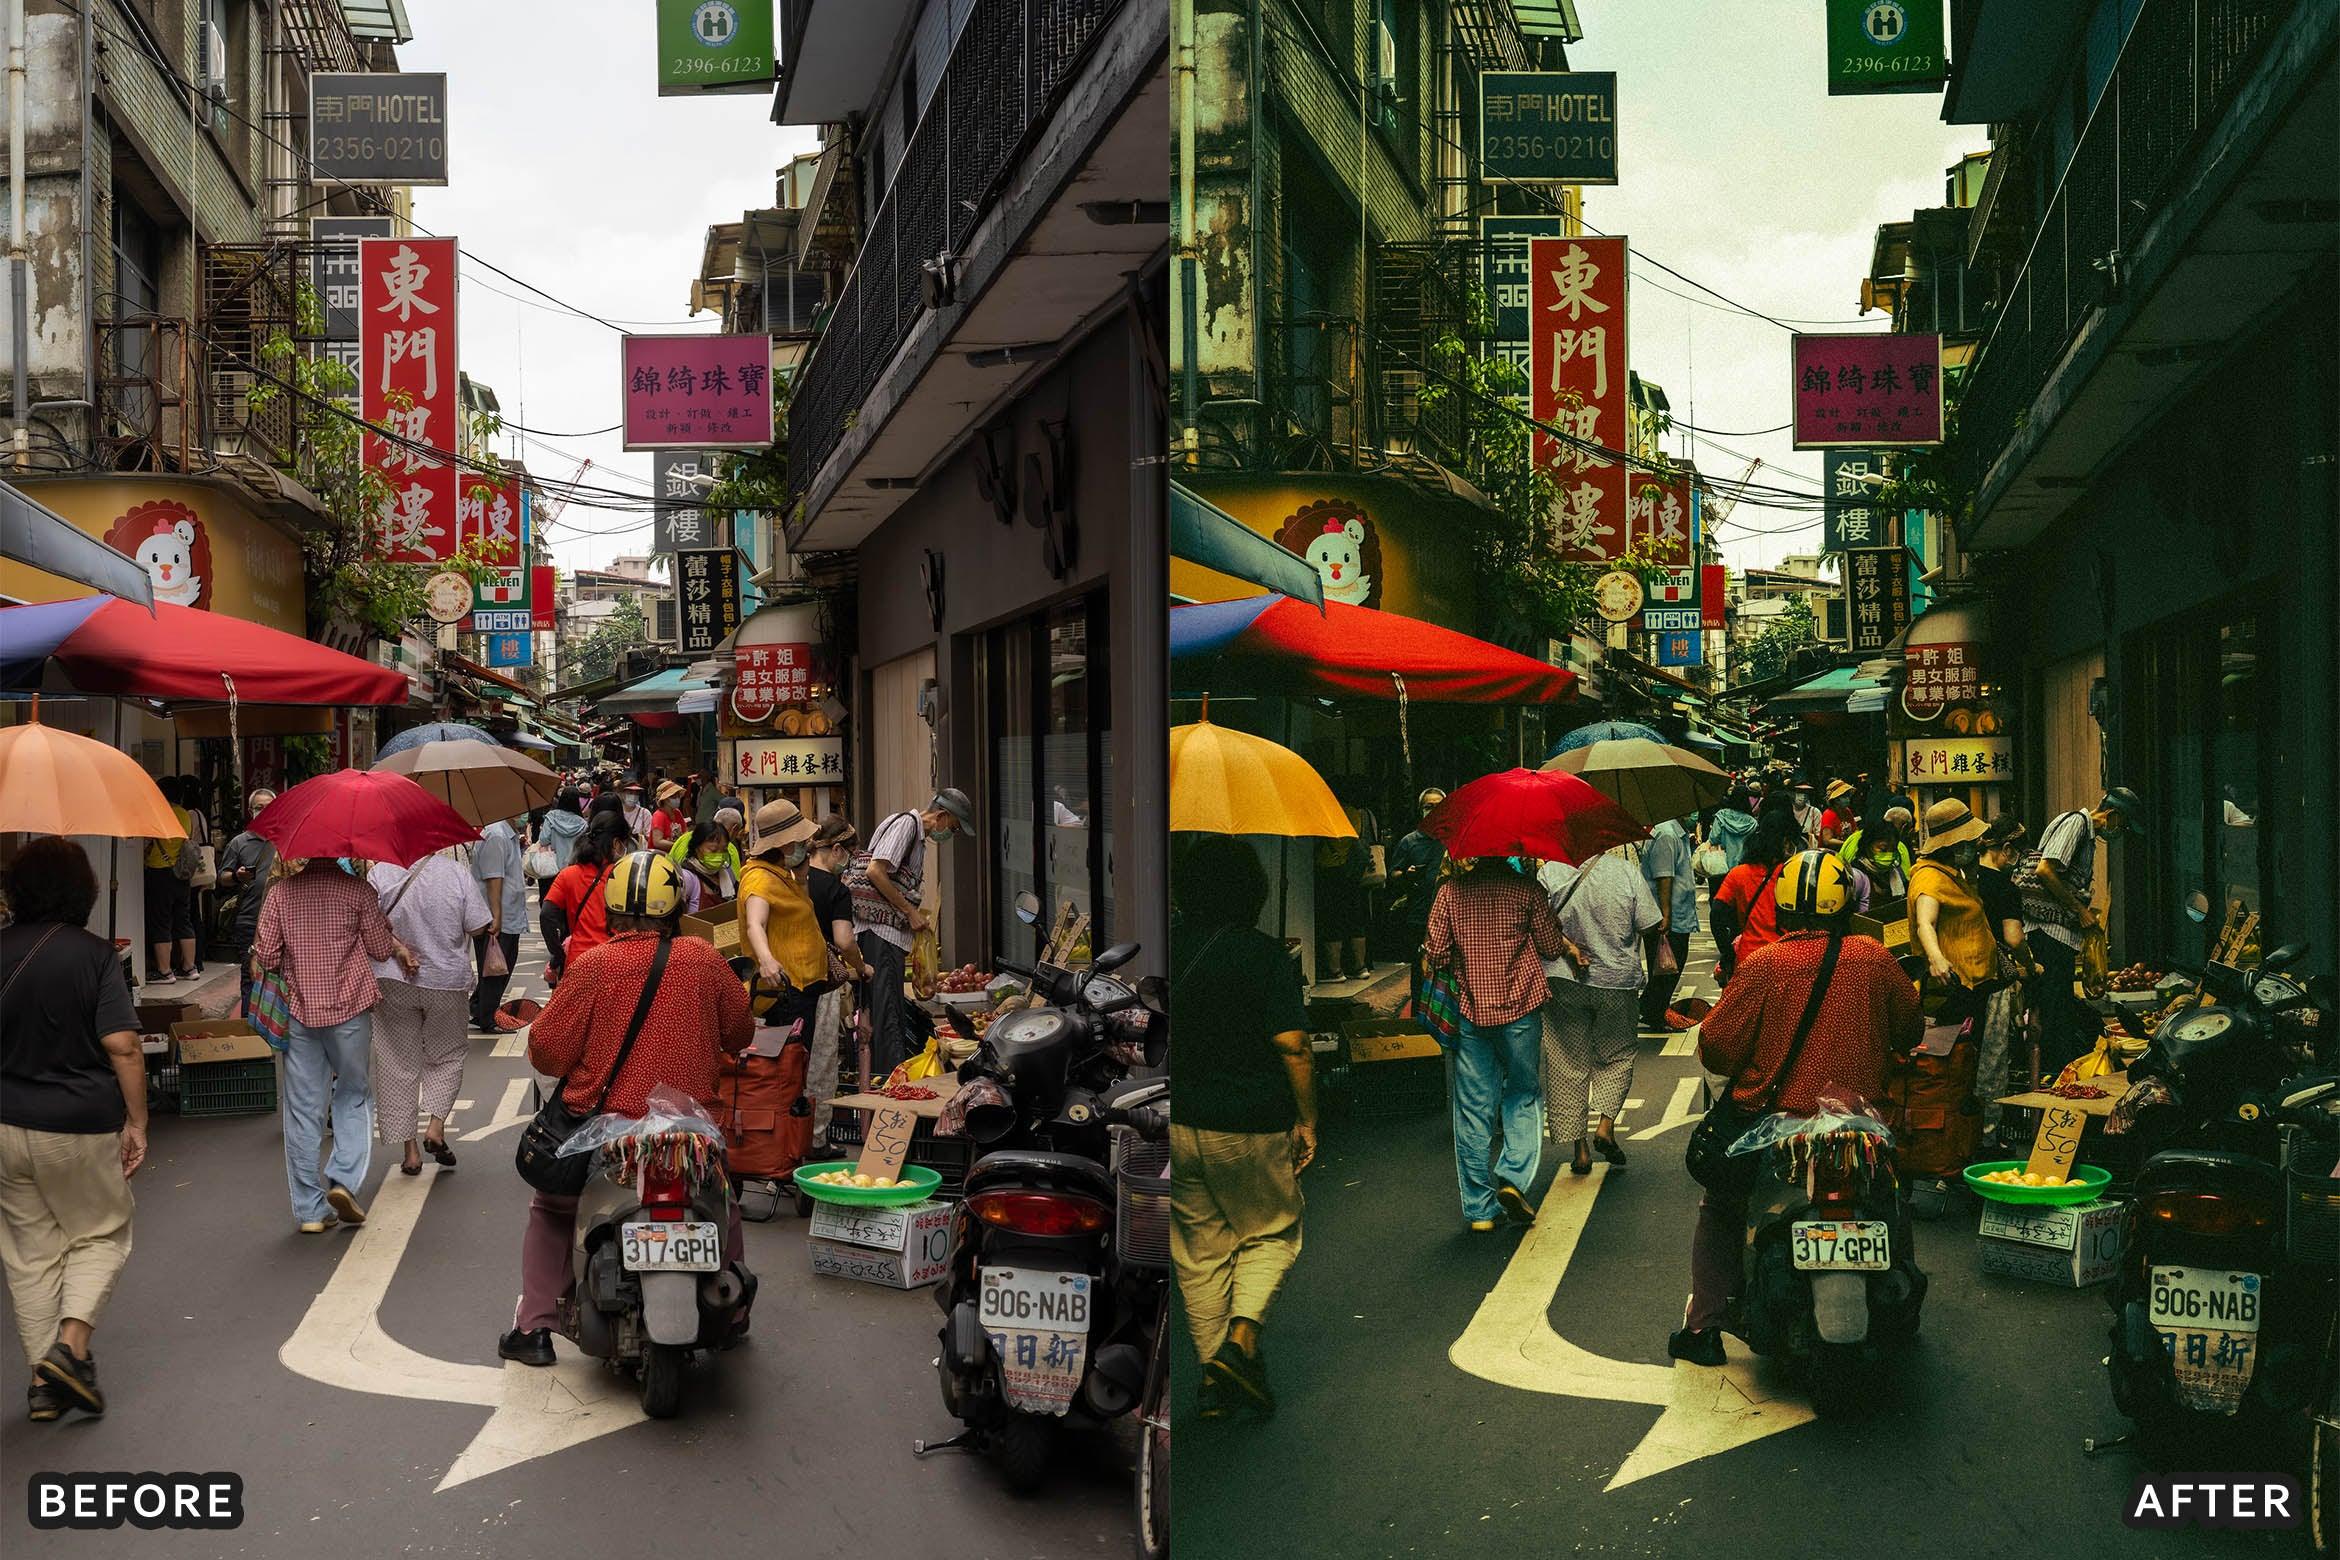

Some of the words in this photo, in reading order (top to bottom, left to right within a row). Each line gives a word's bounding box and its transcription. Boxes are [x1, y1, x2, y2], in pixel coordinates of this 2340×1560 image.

[672, 56, 761, 74] 2396-6123
[1842, 55, 1931, 73] 2396-6123
[316, 95, 373, 123] 東門
[377, 95, 442, 123] HOTEL
[1486, 94, 1543, 122] 東門
[1547, 94, 1612, 122] HOTEL
[317, 137, 442, 160] 2356-0210
[1487, 136, 1612, 159] 2356-0210
[631, 363, 766, 396] 錦綺珠寶
[1801, 362, 1936, 395] 錦綺珠寶
[373, 244, 446, 560] 東門銀樓
[1543, 243, 1616, 559] 東門銀樓
[665, 462, 700, 543] 銀樓
[1835, 461, 1870, 542] 銀樓
[684, 555, 712, 648] 蕾莎精品
[1854, 554, 1882, 647] 蕾莎精品
[742, 668, 807, 685] 男女服飾
[1912, 667, 1977, 684] 男女服飾
[742, 686, 807, 703] 專業修改
[1912, 685, 1977, 702] 專業修改
[740, 751, 842, 776] 東門雞蛋糕
[1910, 750, 2012, 775] 東門雞蛋糕
[1028, 1158, 1062, 1166] YAMAHA
